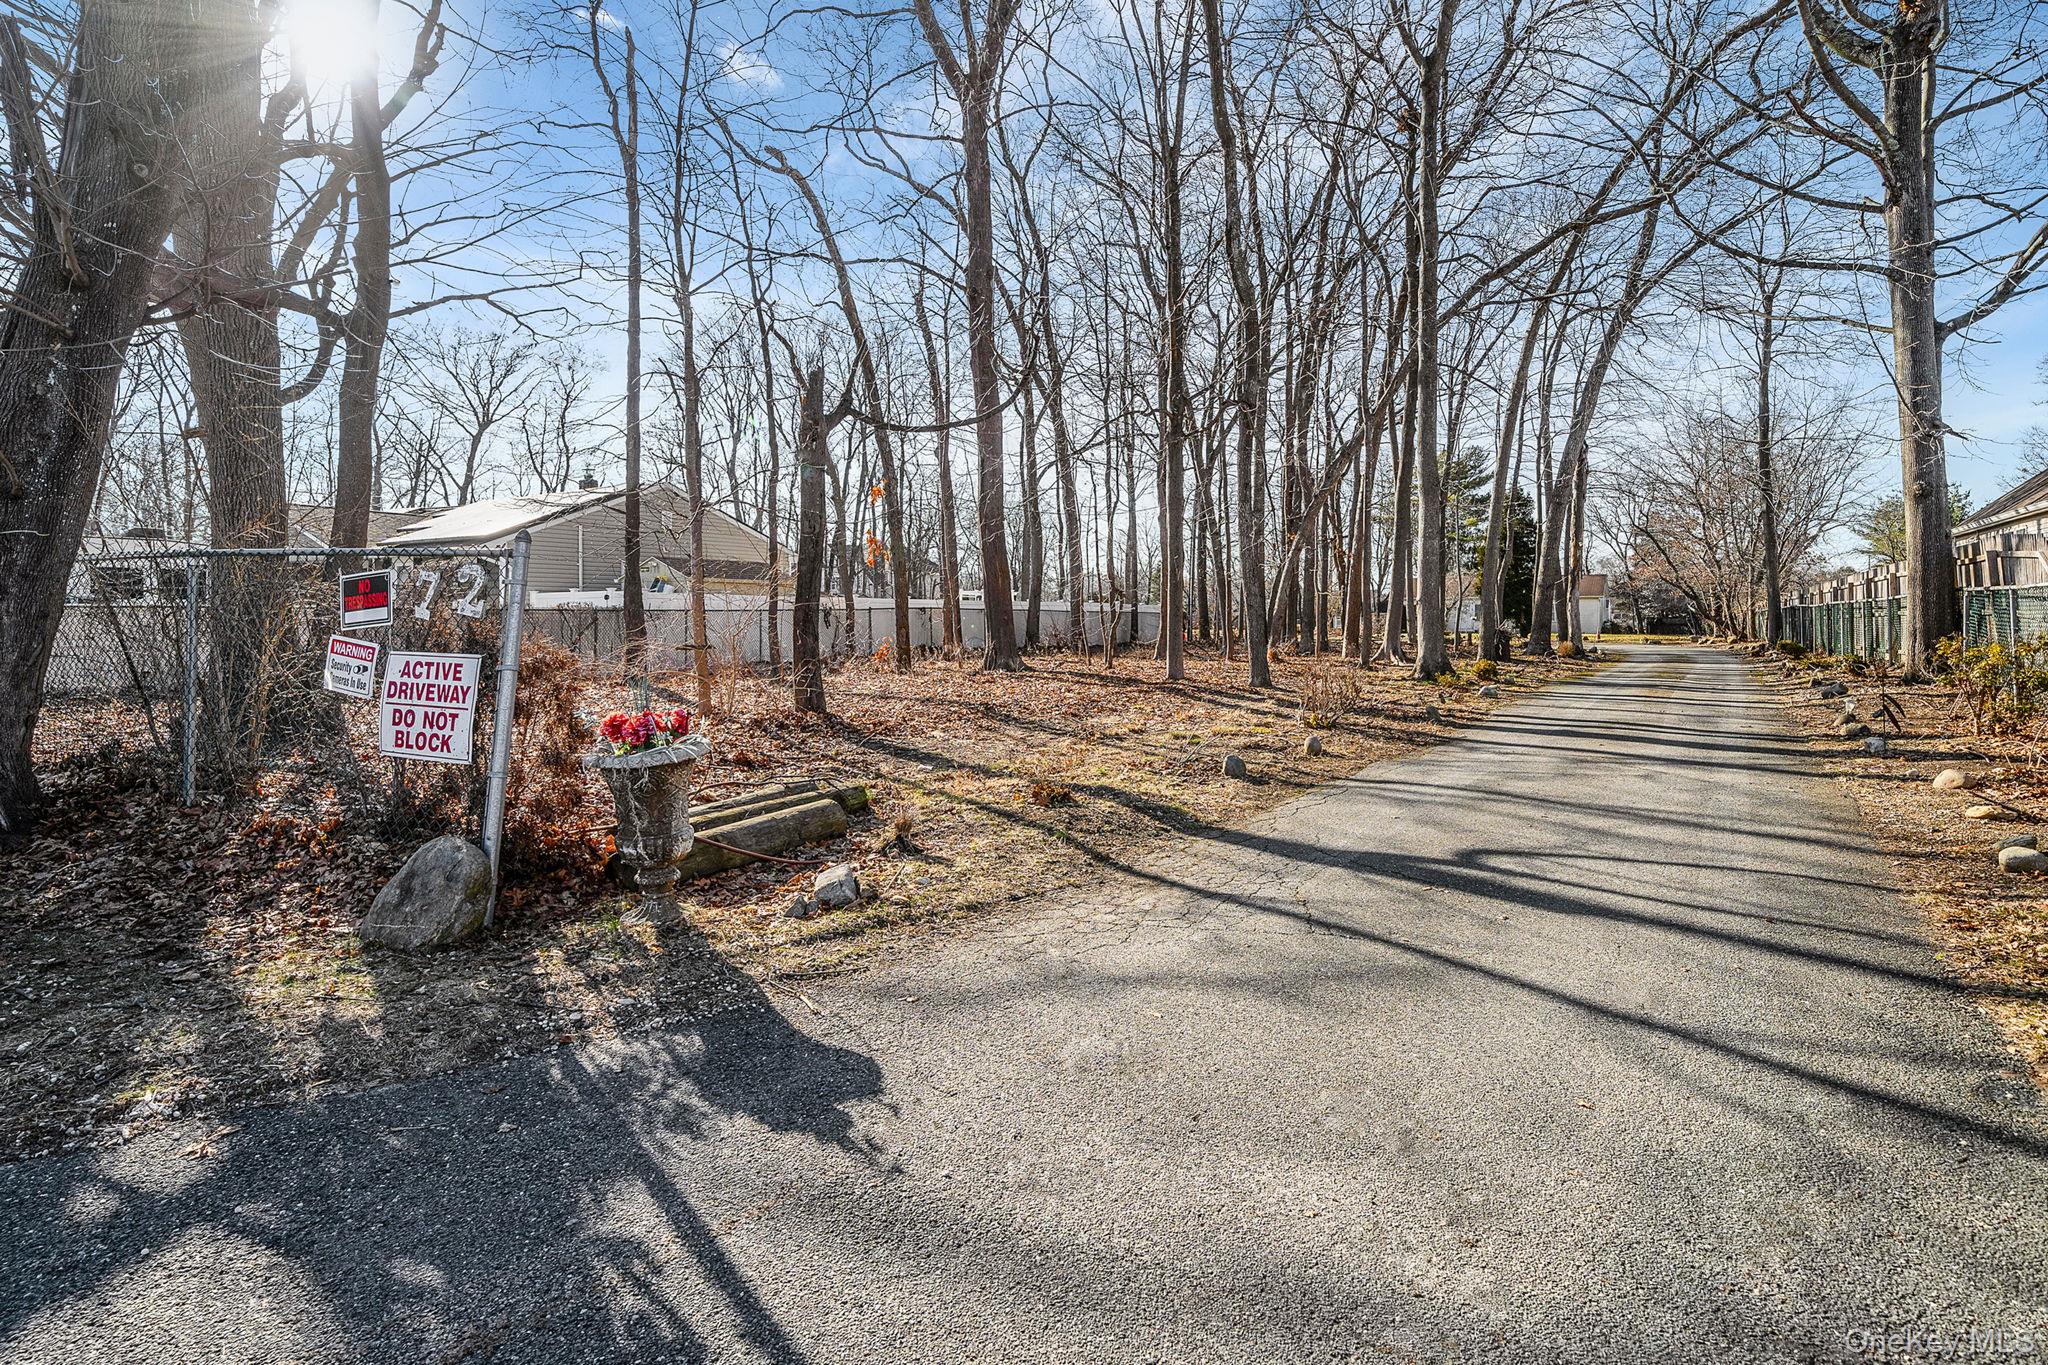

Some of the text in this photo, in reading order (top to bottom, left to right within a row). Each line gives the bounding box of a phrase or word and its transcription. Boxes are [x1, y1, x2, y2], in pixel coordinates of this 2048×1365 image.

[358, 579, 370, 593] NO
[344, 594, 388, 611] TRESPASSING
[333, 641, 373, 660] WARNING
[331, 658, 352, 675] Security
[400, 660, 464, 682] ACTIVE
[350, 677, 356, 688] In
[356, 678, 366, 690] Use
[386, 681, 471, 704] DRIVEWAY
[391, 708, 459, 731] DO NOT
[394, 730, 453, 753] BLOCK
